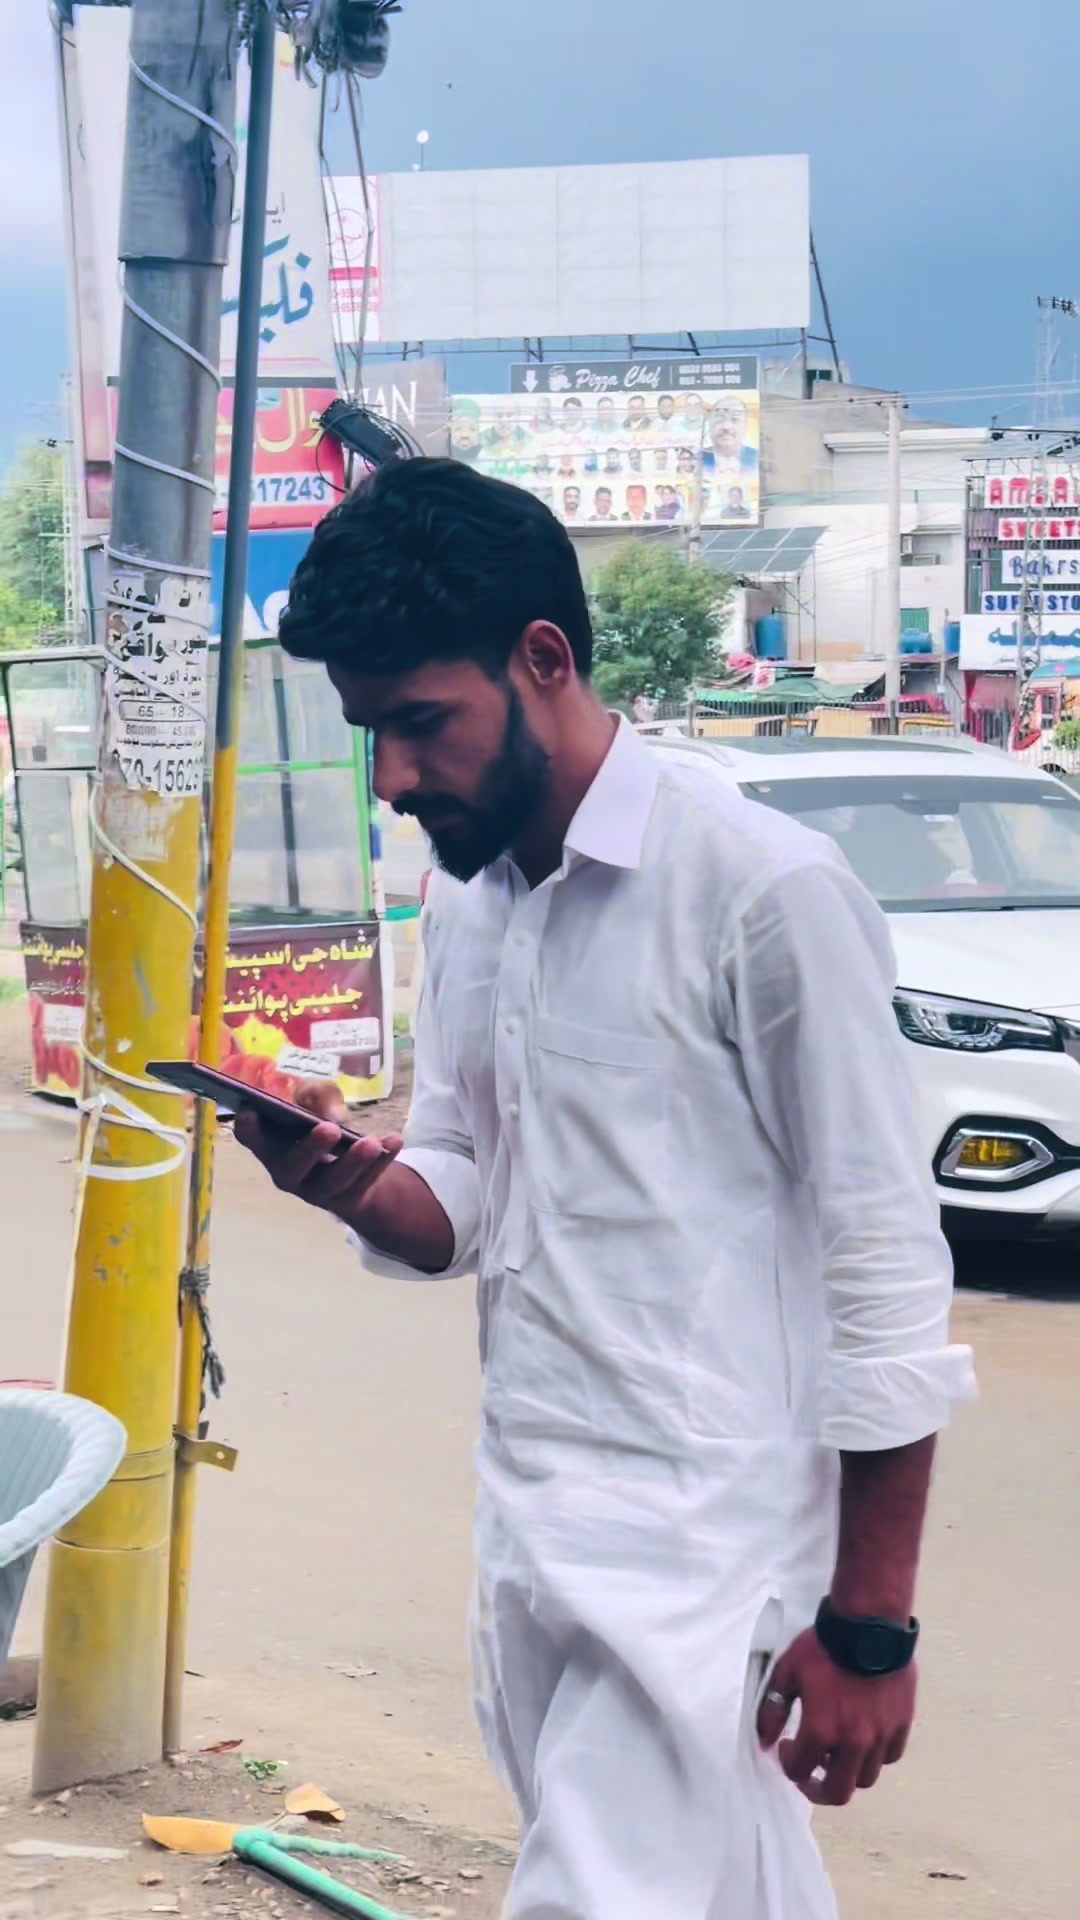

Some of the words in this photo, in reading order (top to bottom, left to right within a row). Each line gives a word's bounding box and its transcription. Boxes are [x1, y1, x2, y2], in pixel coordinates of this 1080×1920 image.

[575, 368, 618, 392] Pizza
[624, 365, 661, 389] Chef
[250, 476, 326, 502] 17243
[330, 928, 374, 961] شاہ
[292, 946, 329, 972] جی
[289, 983, 363, 1016] جلیبی
